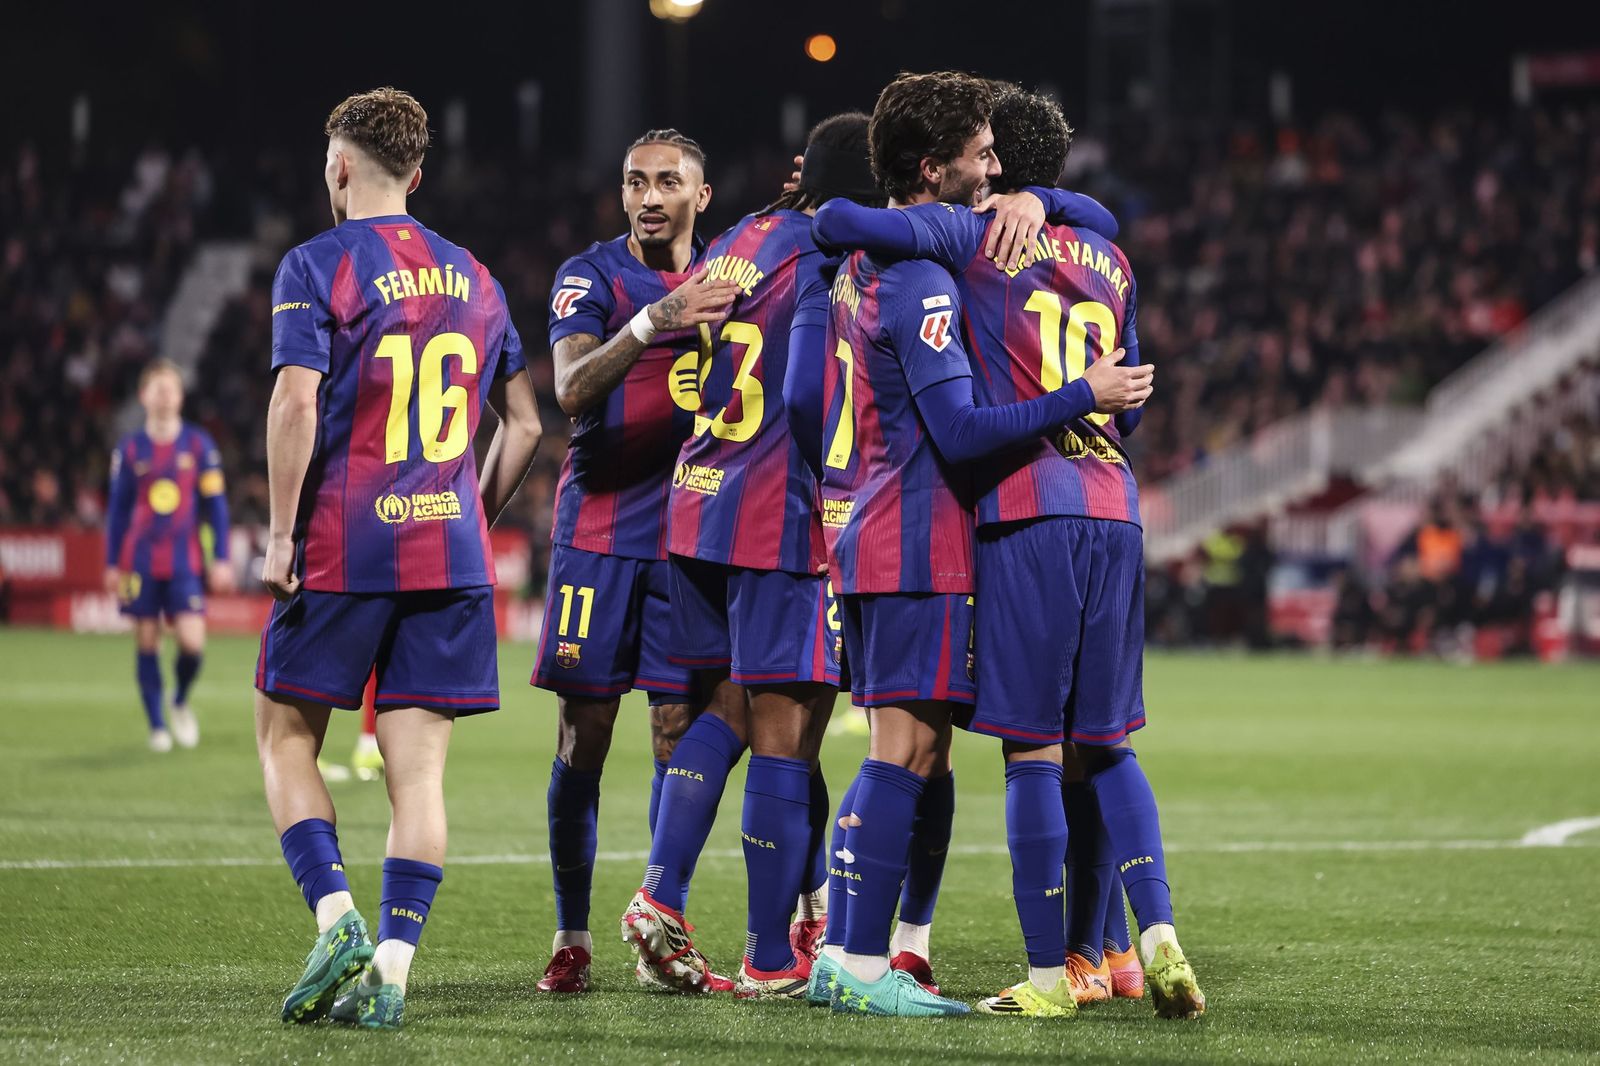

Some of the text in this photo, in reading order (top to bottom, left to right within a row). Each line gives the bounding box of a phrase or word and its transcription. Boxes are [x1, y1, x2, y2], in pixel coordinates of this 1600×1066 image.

[373, 264, 471, 305] FERMÍN
[1065, 240, 1128, 302] YAMAL
[1023, 290, 1116, 426] 10
[374, 332, 478, 465] 16
[685, 475, 721, 492] ACNUR
[690, 464, 725, 481] UNHCR
[411, 491, 459, 506] UNHCR
[413, 502, 461, 518] ACNUR
[558, 584, 595, 639] 11
